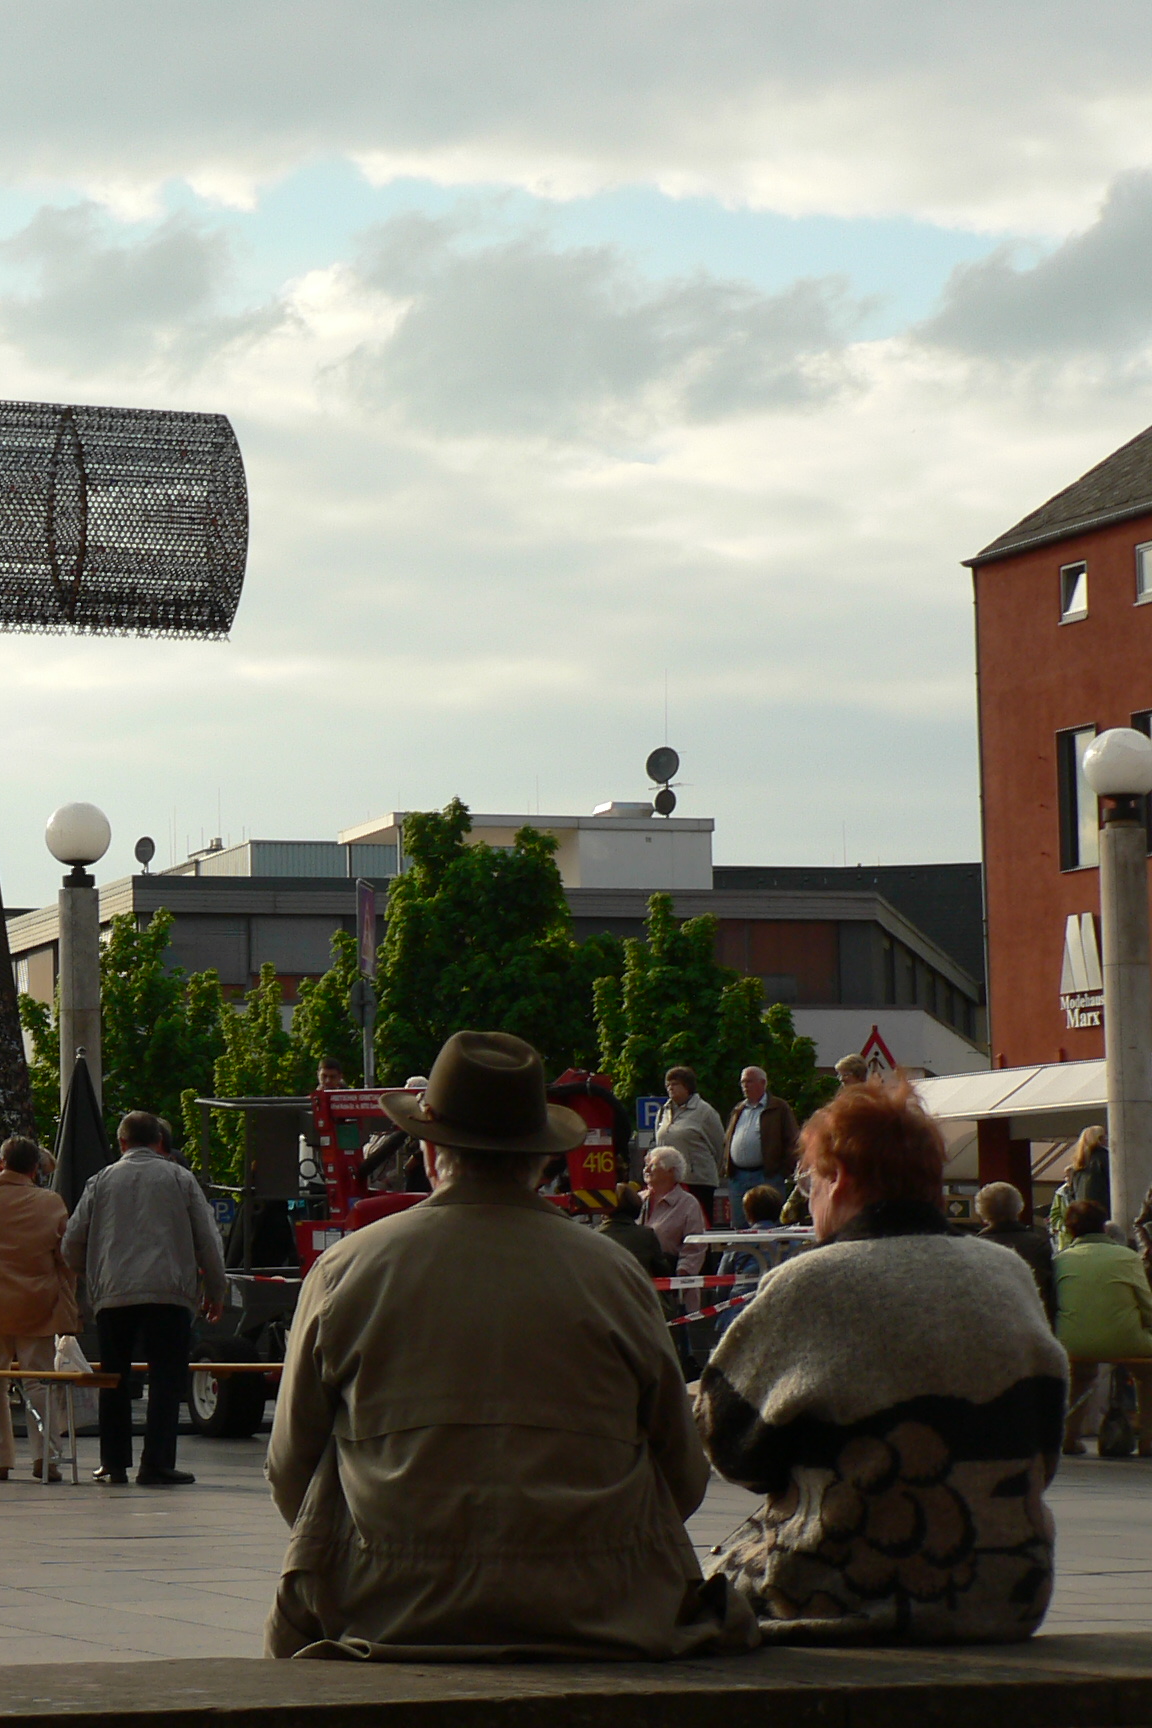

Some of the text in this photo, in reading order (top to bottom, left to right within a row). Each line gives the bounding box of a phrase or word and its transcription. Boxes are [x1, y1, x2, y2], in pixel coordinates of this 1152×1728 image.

[1066, 1009, 1100, 1029] Marx
[645, 1101, 661, 1126] P
[582, 1151, 614, 1173] 416
[216, 1201, 228, 1220] P
